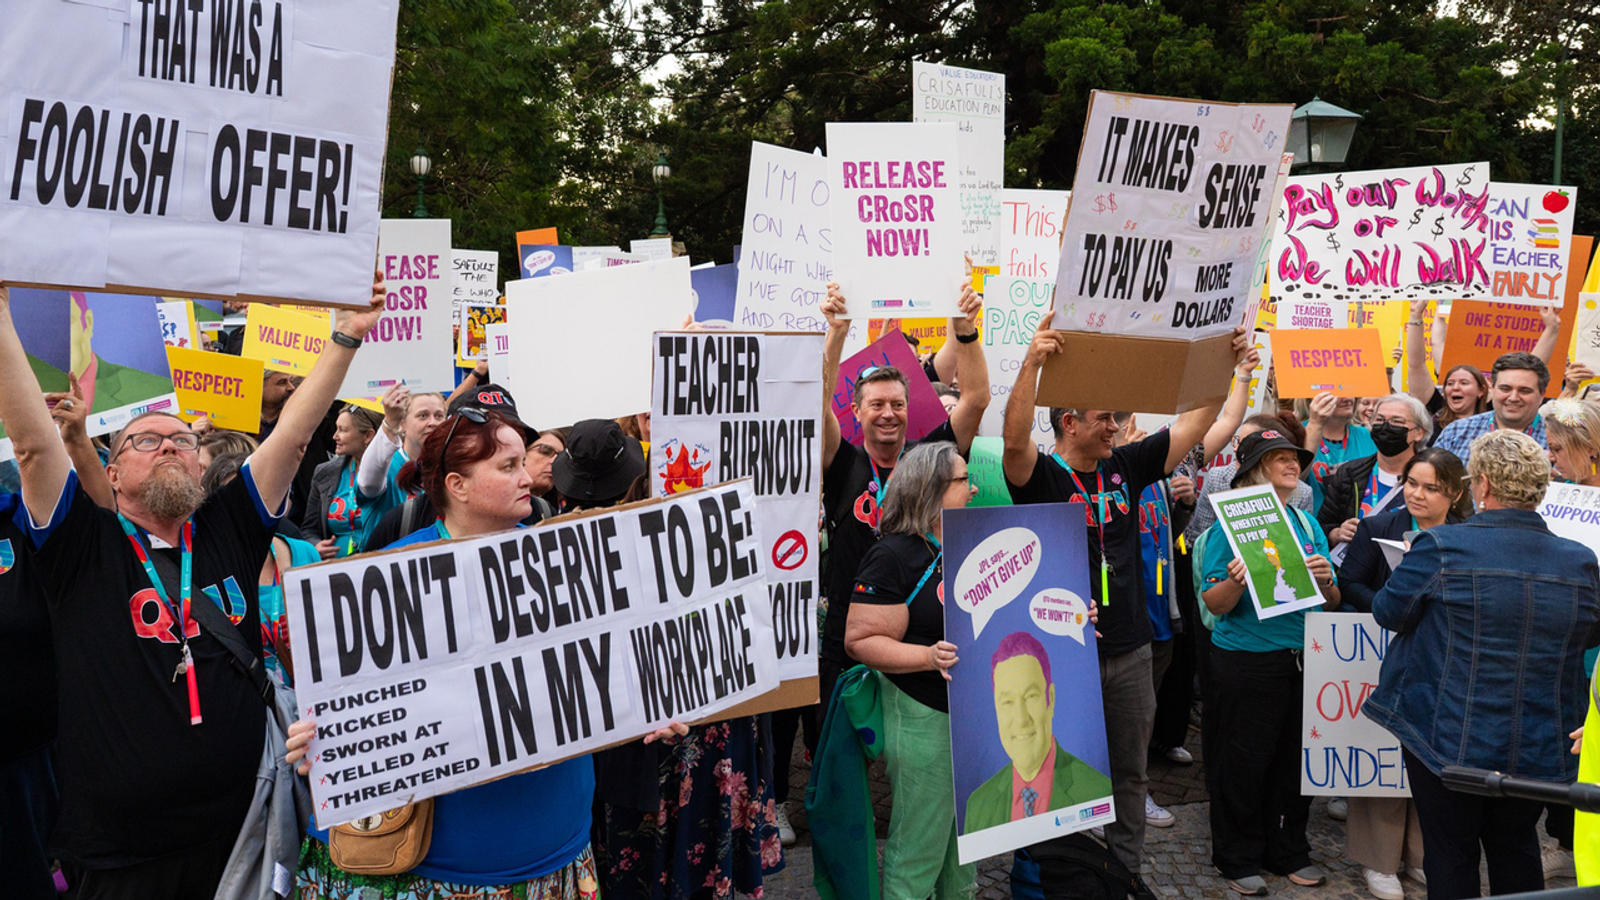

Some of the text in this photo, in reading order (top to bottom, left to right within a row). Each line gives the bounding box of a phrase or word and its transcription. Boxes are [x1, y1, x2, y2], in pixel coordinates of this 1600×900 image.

[137, 0, 283, 97] THAT WAS A
[940, 68, 961, 79] VALUE
[924, 96, 1001, 115] EDUCATION PLAN
[10, 98, 354, 234] FOOLISH OFFER!
[1098, 116, 1200, 193] IT MAKES
[765, 161, 797, 205] I'M
[842, 160, 947, 189] RELEASE
[857, 194, 935, 223] CRoSR
[1197, 162, 1267, 229] SENSE
[1283, 181, 1340, 234] Pay
[1346, 177, 1411, 210] our
[753, 213, 782, 238] ON
[795, 224, 808, 245] A
[1002, 201, 1057, 238] This
[1353, 214, 1400, 239] or
[866, 228, 930, 257] NOW!
[750, 250, 797, 275] NIGHT
[1078, 233, 1173, 303] TO PAY US
[1277, 233, 1332, 285] We
[749, 281, 780, 300] I'VE
[1194, 262, 1233, 293] MORE
[1492, 271, 1563, 301] FAIRLY.
[742, 306, 775, 329] AND
[1171, 296, 1234, 329] DOLLARS
[1291, 316, 1334, 329] SHORTAGE
[1294, 305, 1332, 318] TEACHER
[1465, 311, 1492, 329] ONE
[259, 325, 300, 350] VALUE
[909, 327, 934, 338] VALUE
[1474, 333, 1492, 347] AT
[1493, 335, 1502, 349] A
[1290, 349, 1367, 368] RESPECT.
[173, 369, 245, 399] RESPECT.
[659, 335, 760, 416] TEACHER
[719, 418, 815, 496] BURNOUT
[1223, 496, 1275, 519] CRISAFULLI
[1230, 512, 1280, 531] WHEN IT'S TIME
[1236, 528, 1269, 544] TO PAY UP
[978, 558, 992, 575] JPL
[999, 552, 1023, 584] GIVE
[300, 489, 759, 684] I DON'T DESERVE TO BE:
[474, 593, 757, 768] IN MY WORKPLACE
[314, 678, 428, 717] PUNCHED
[318, 707, 408, 740] KICKED
[321, 721, 443, 763] SWORN AT
[325, 742, 450, 786] YELLED AT
[328, 757, 481, 809] THREATENED
